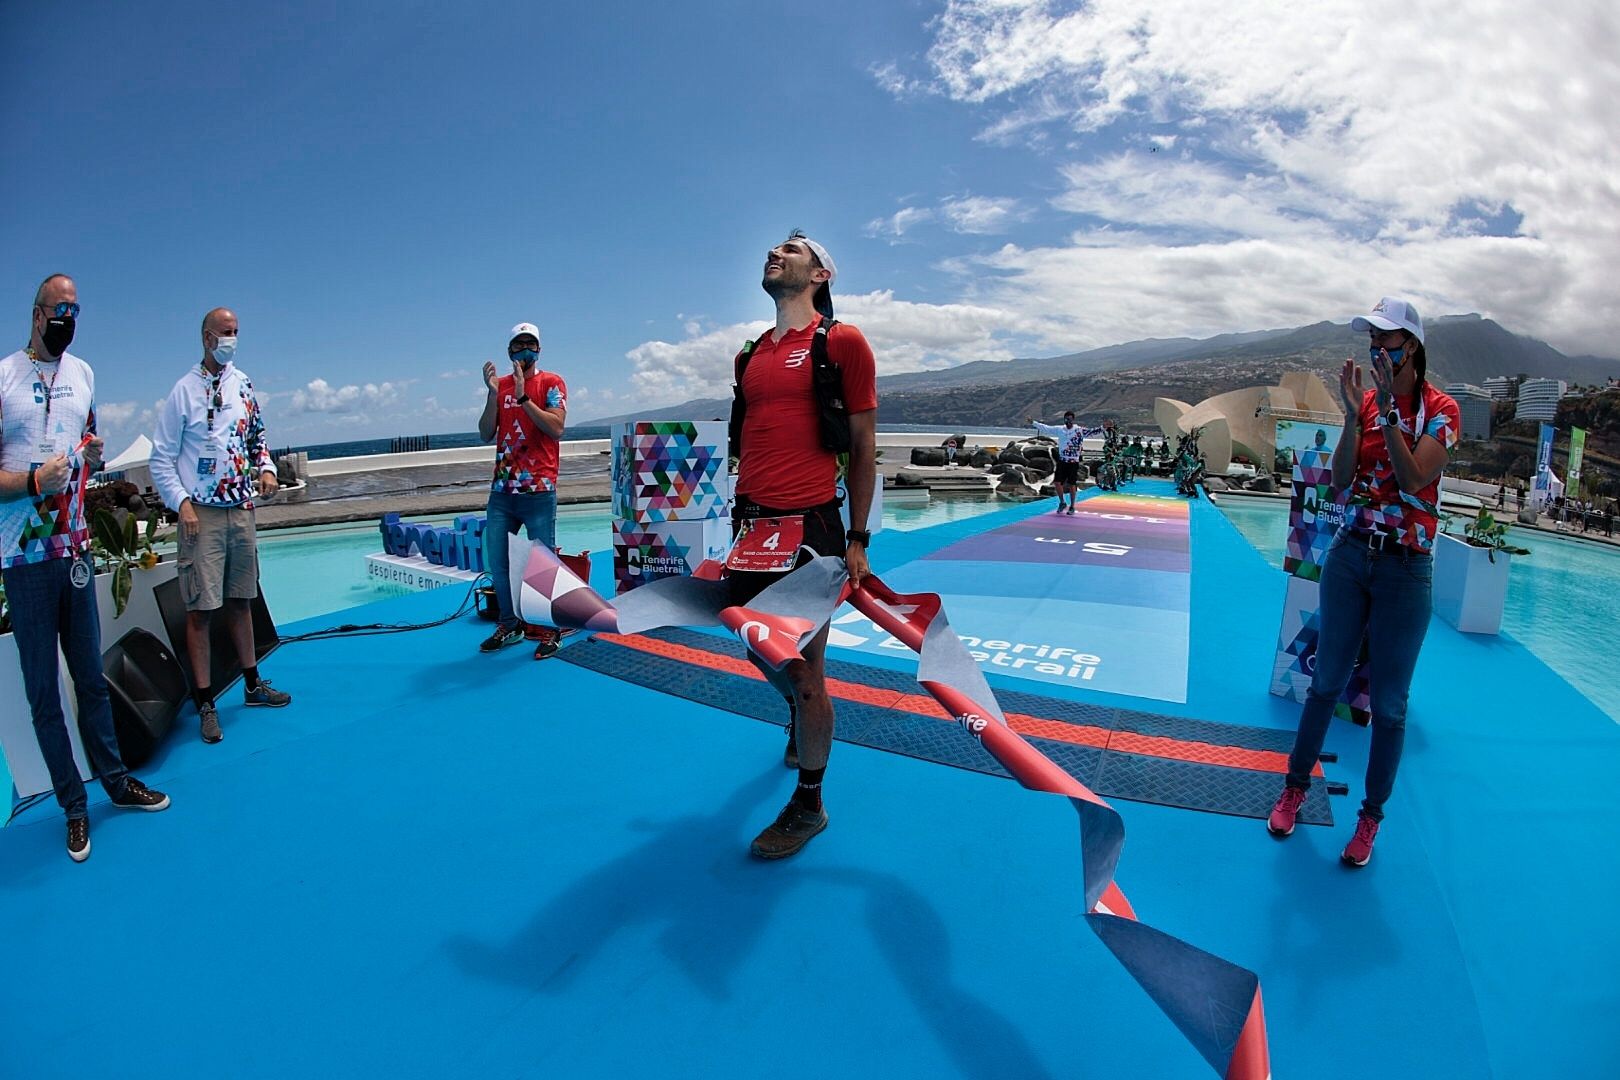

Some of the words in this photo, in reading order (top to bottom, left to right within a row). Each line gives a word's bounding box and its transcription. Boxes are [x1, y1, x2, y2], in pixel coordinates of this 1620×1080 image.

[379, 512, 488, 573] tenerif
[763, 532, 780, 550] 4
[1081, 542, 1134, 556] 5
[641, 555, 684, 565] Tenerife
[368, 560, 414, 585] despierta
[642, 564, 684, 574] Bluetrail
